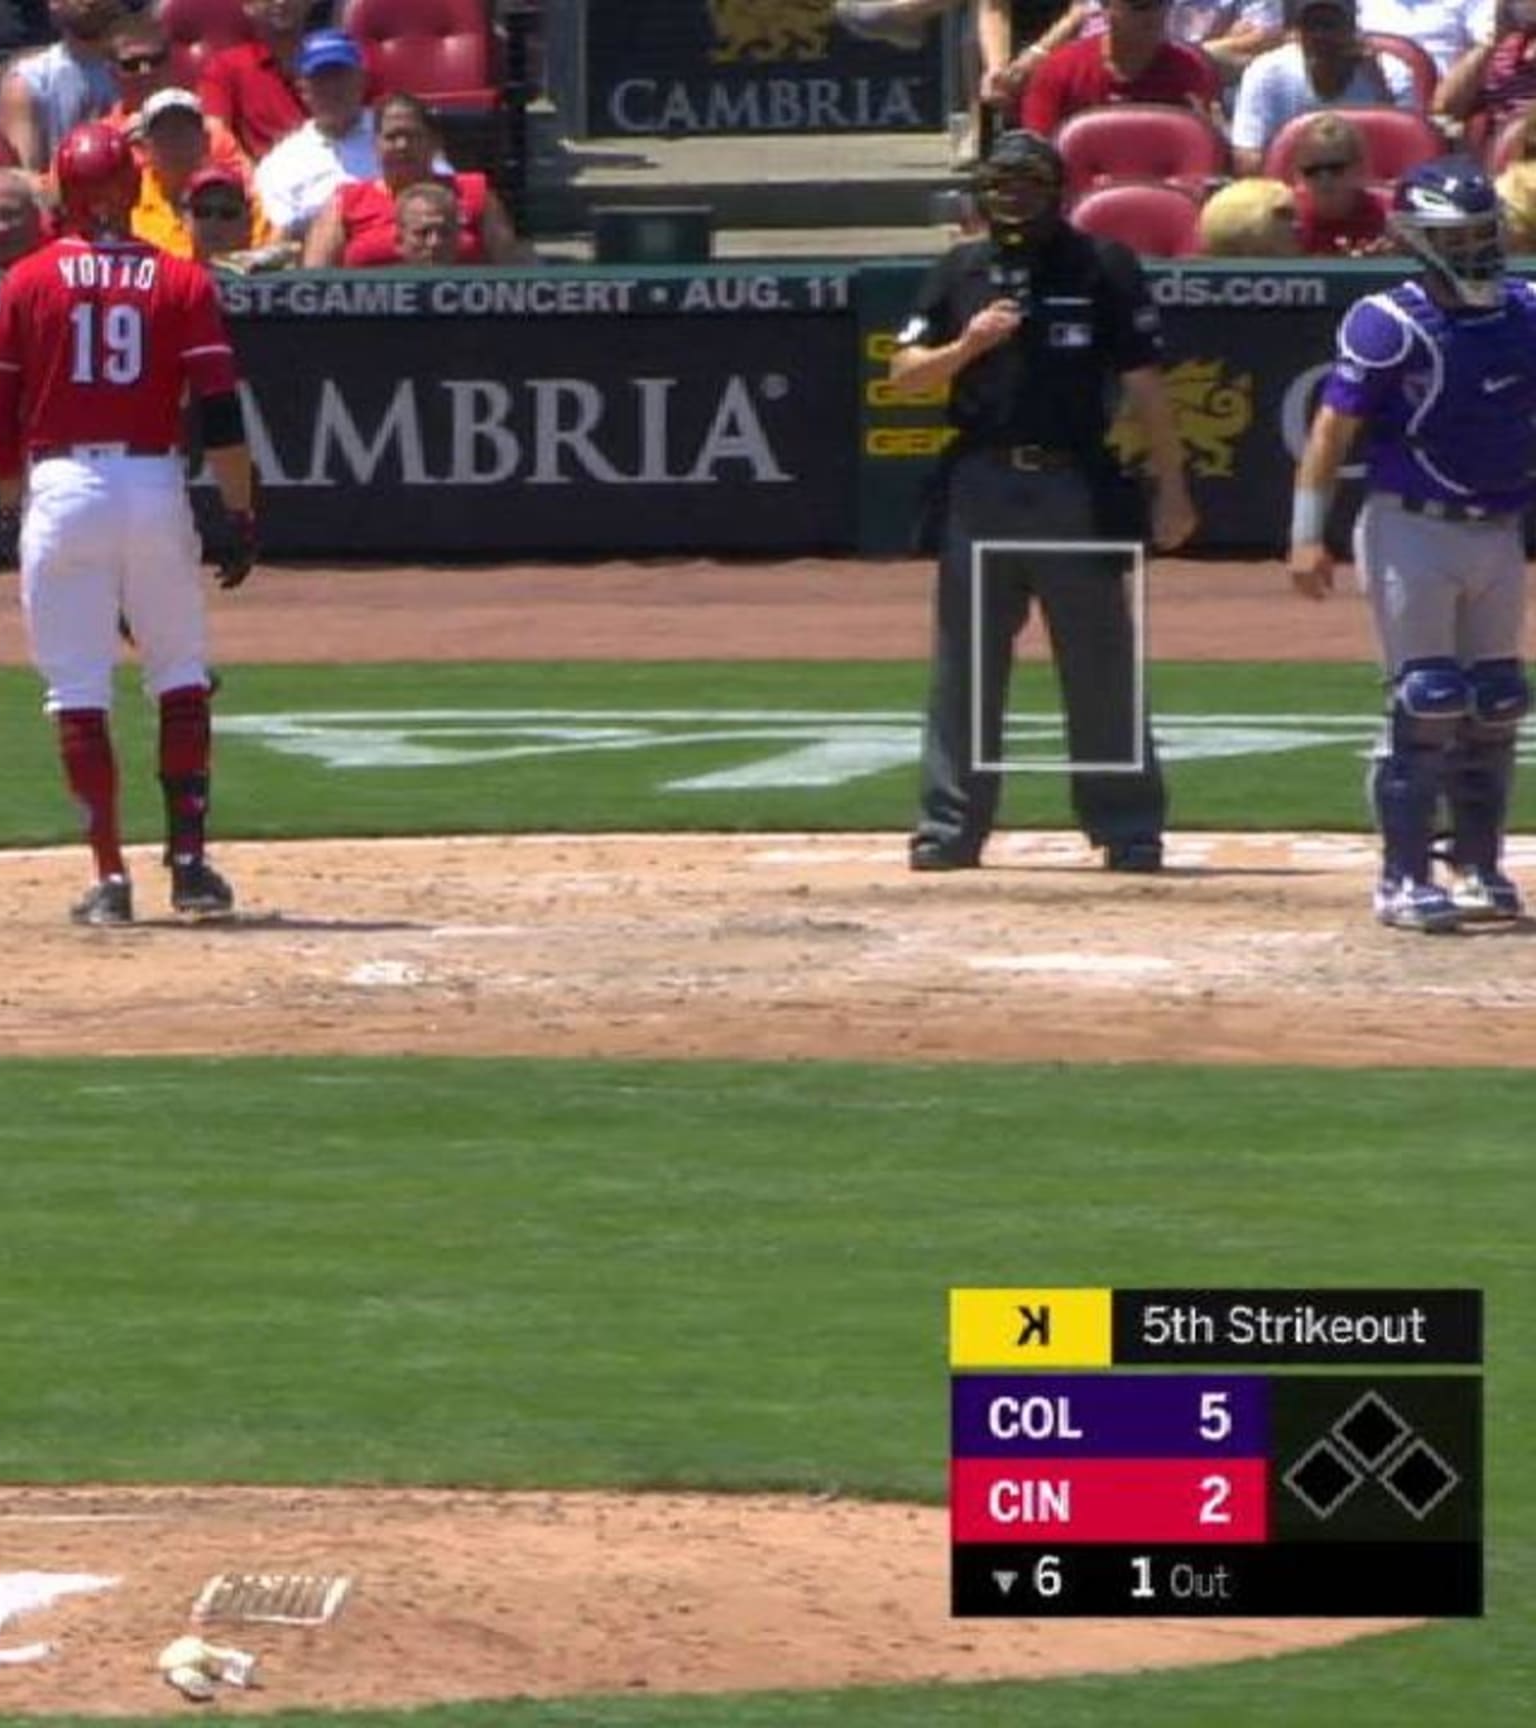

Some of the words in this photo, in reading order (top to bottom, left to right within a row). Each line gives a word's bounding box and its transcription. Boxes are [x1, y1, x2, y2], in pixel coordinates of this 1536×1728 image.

[607, 77, 922, 132] CAMBRIA
[57, 254, 156, 290] VOTTO
[224, 280, 419, 315] ST-GAME
[431, 278, 638, 315] CONCERT
[679, 276, 791, 312] AUG.
[805, 275, 849, 310] 11
[1150, 271, 1327, 306] ds.com
[69, 302, 144, 385] 19
[190, 374, 798, 487] AMBRIA
